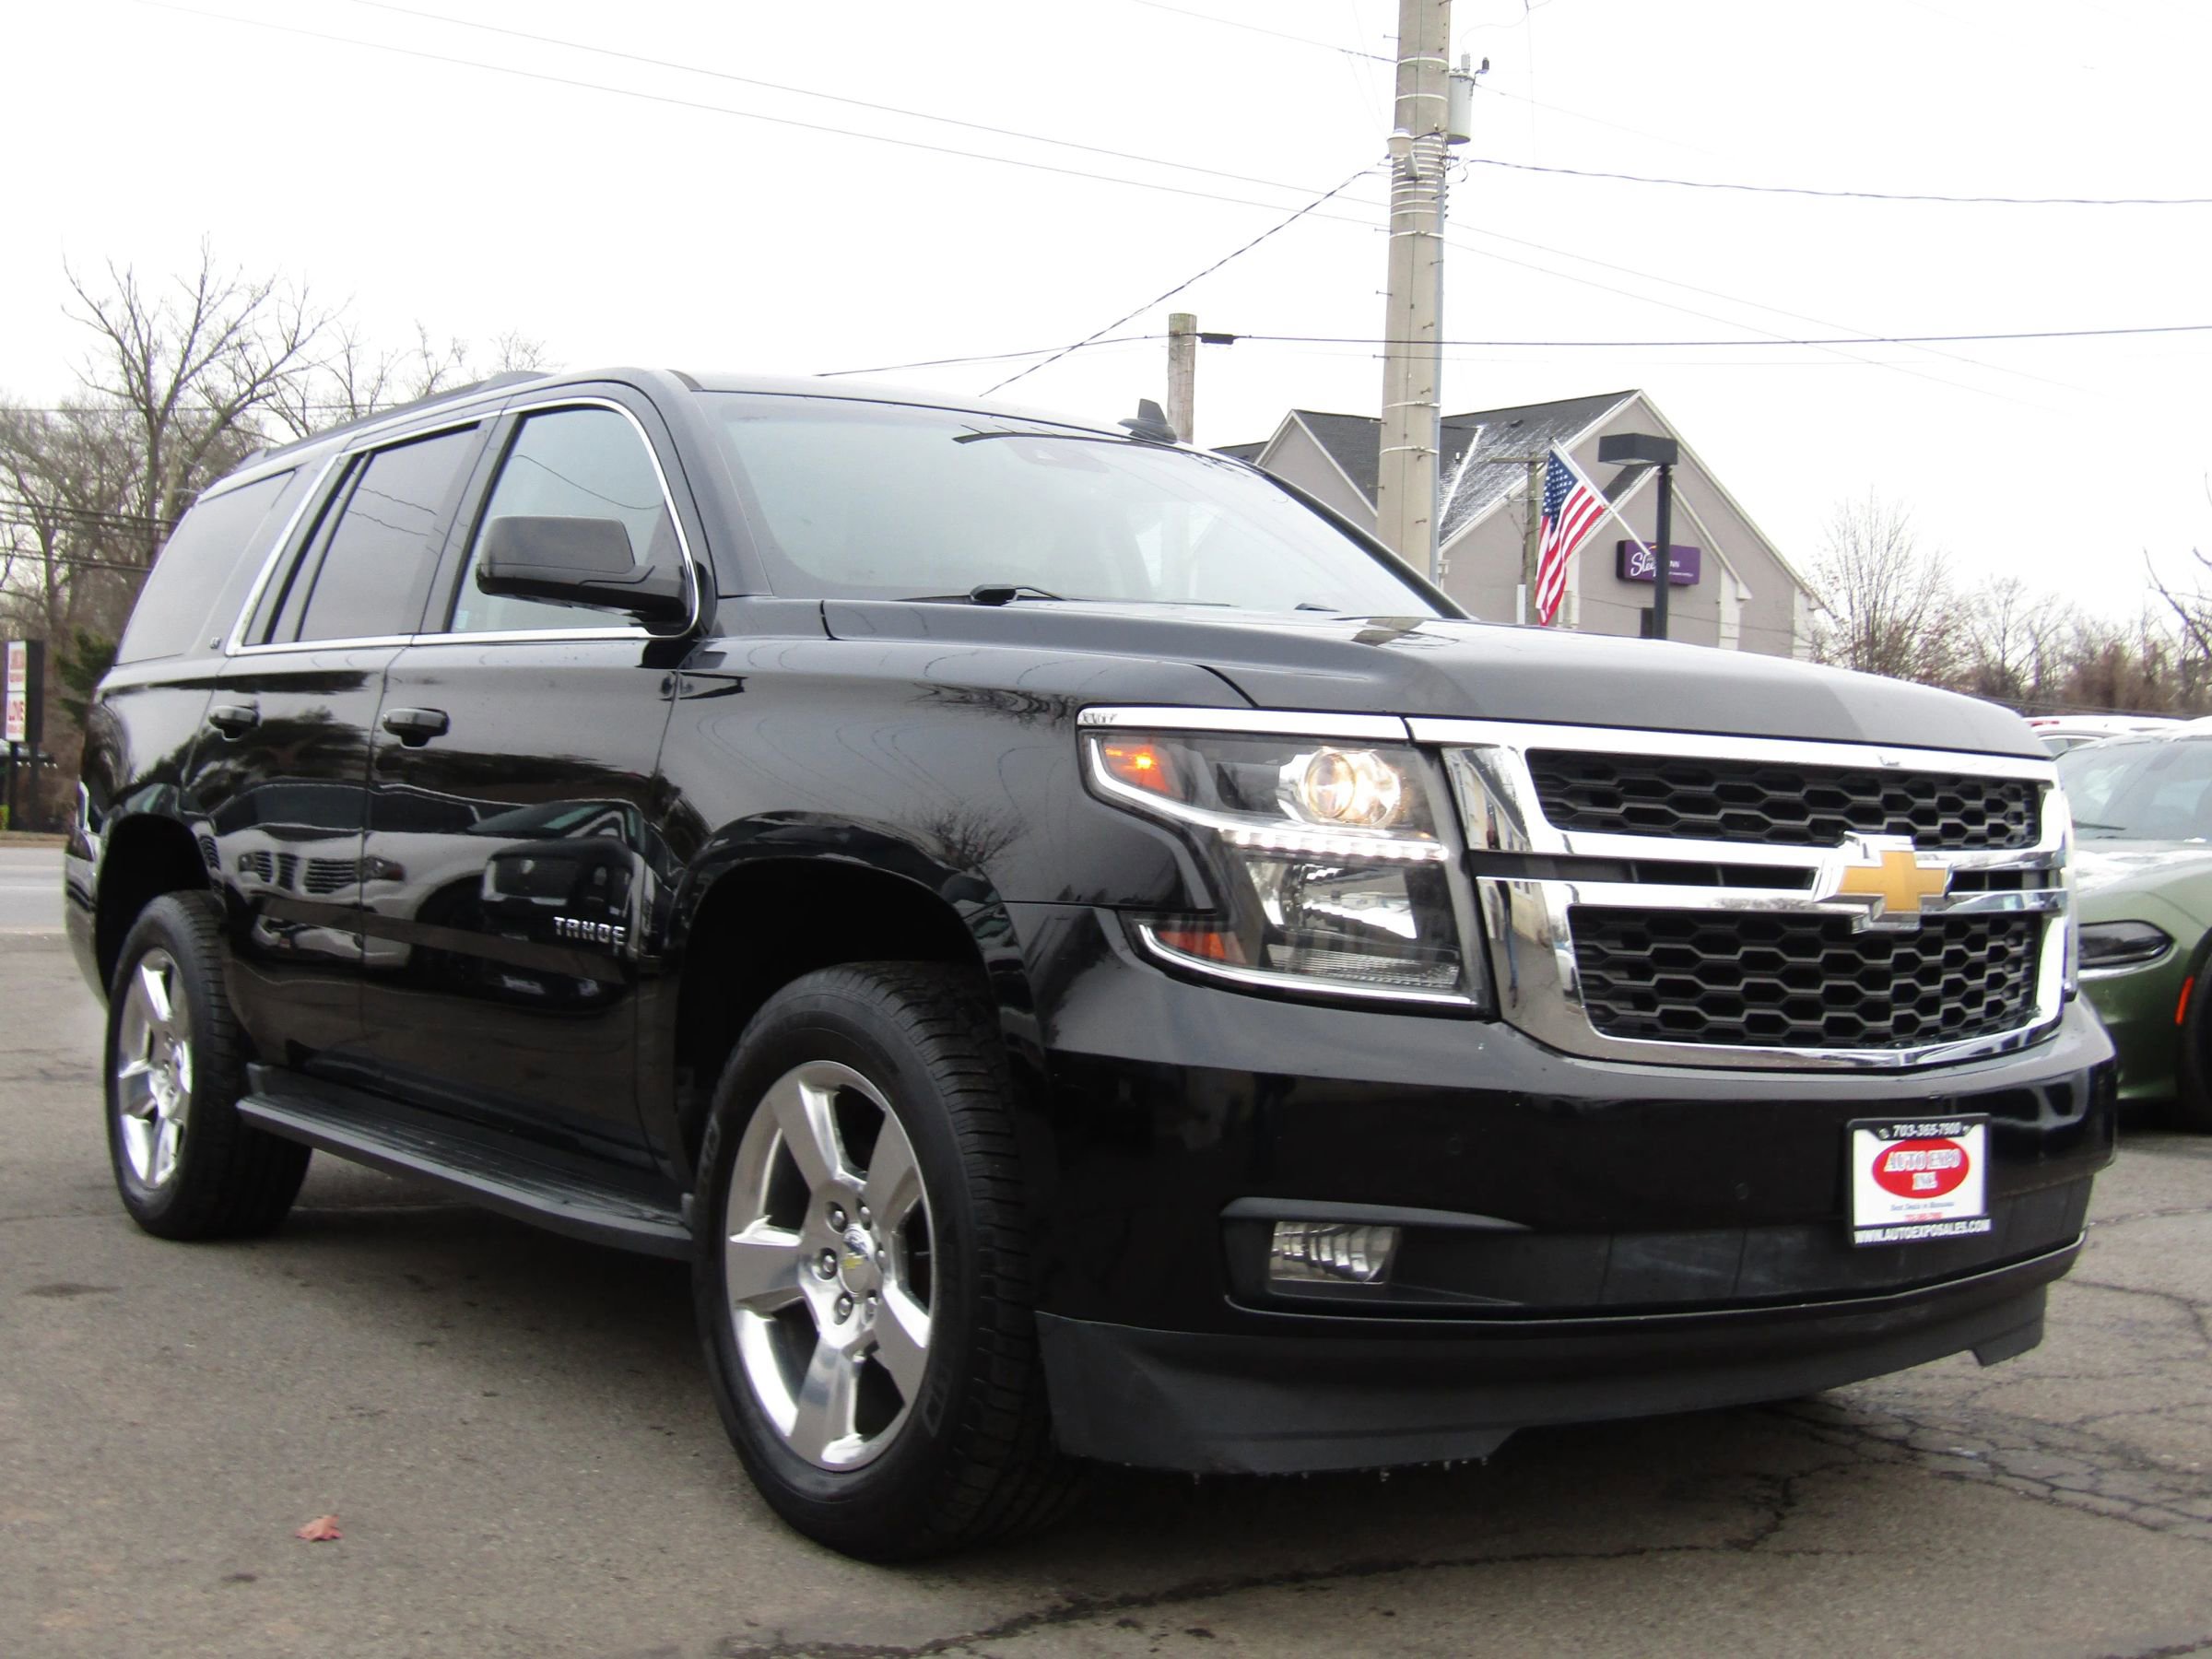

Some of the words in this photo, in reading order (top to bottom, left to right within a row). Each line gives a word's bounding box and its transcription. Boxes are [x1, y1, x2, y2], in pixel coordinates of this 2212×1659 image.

[553, 916, 626, 946] TAHOE
[1884, 1151, 1926, 1172] AUTO
[1925, 1148, 1962, 1170] EXPO
